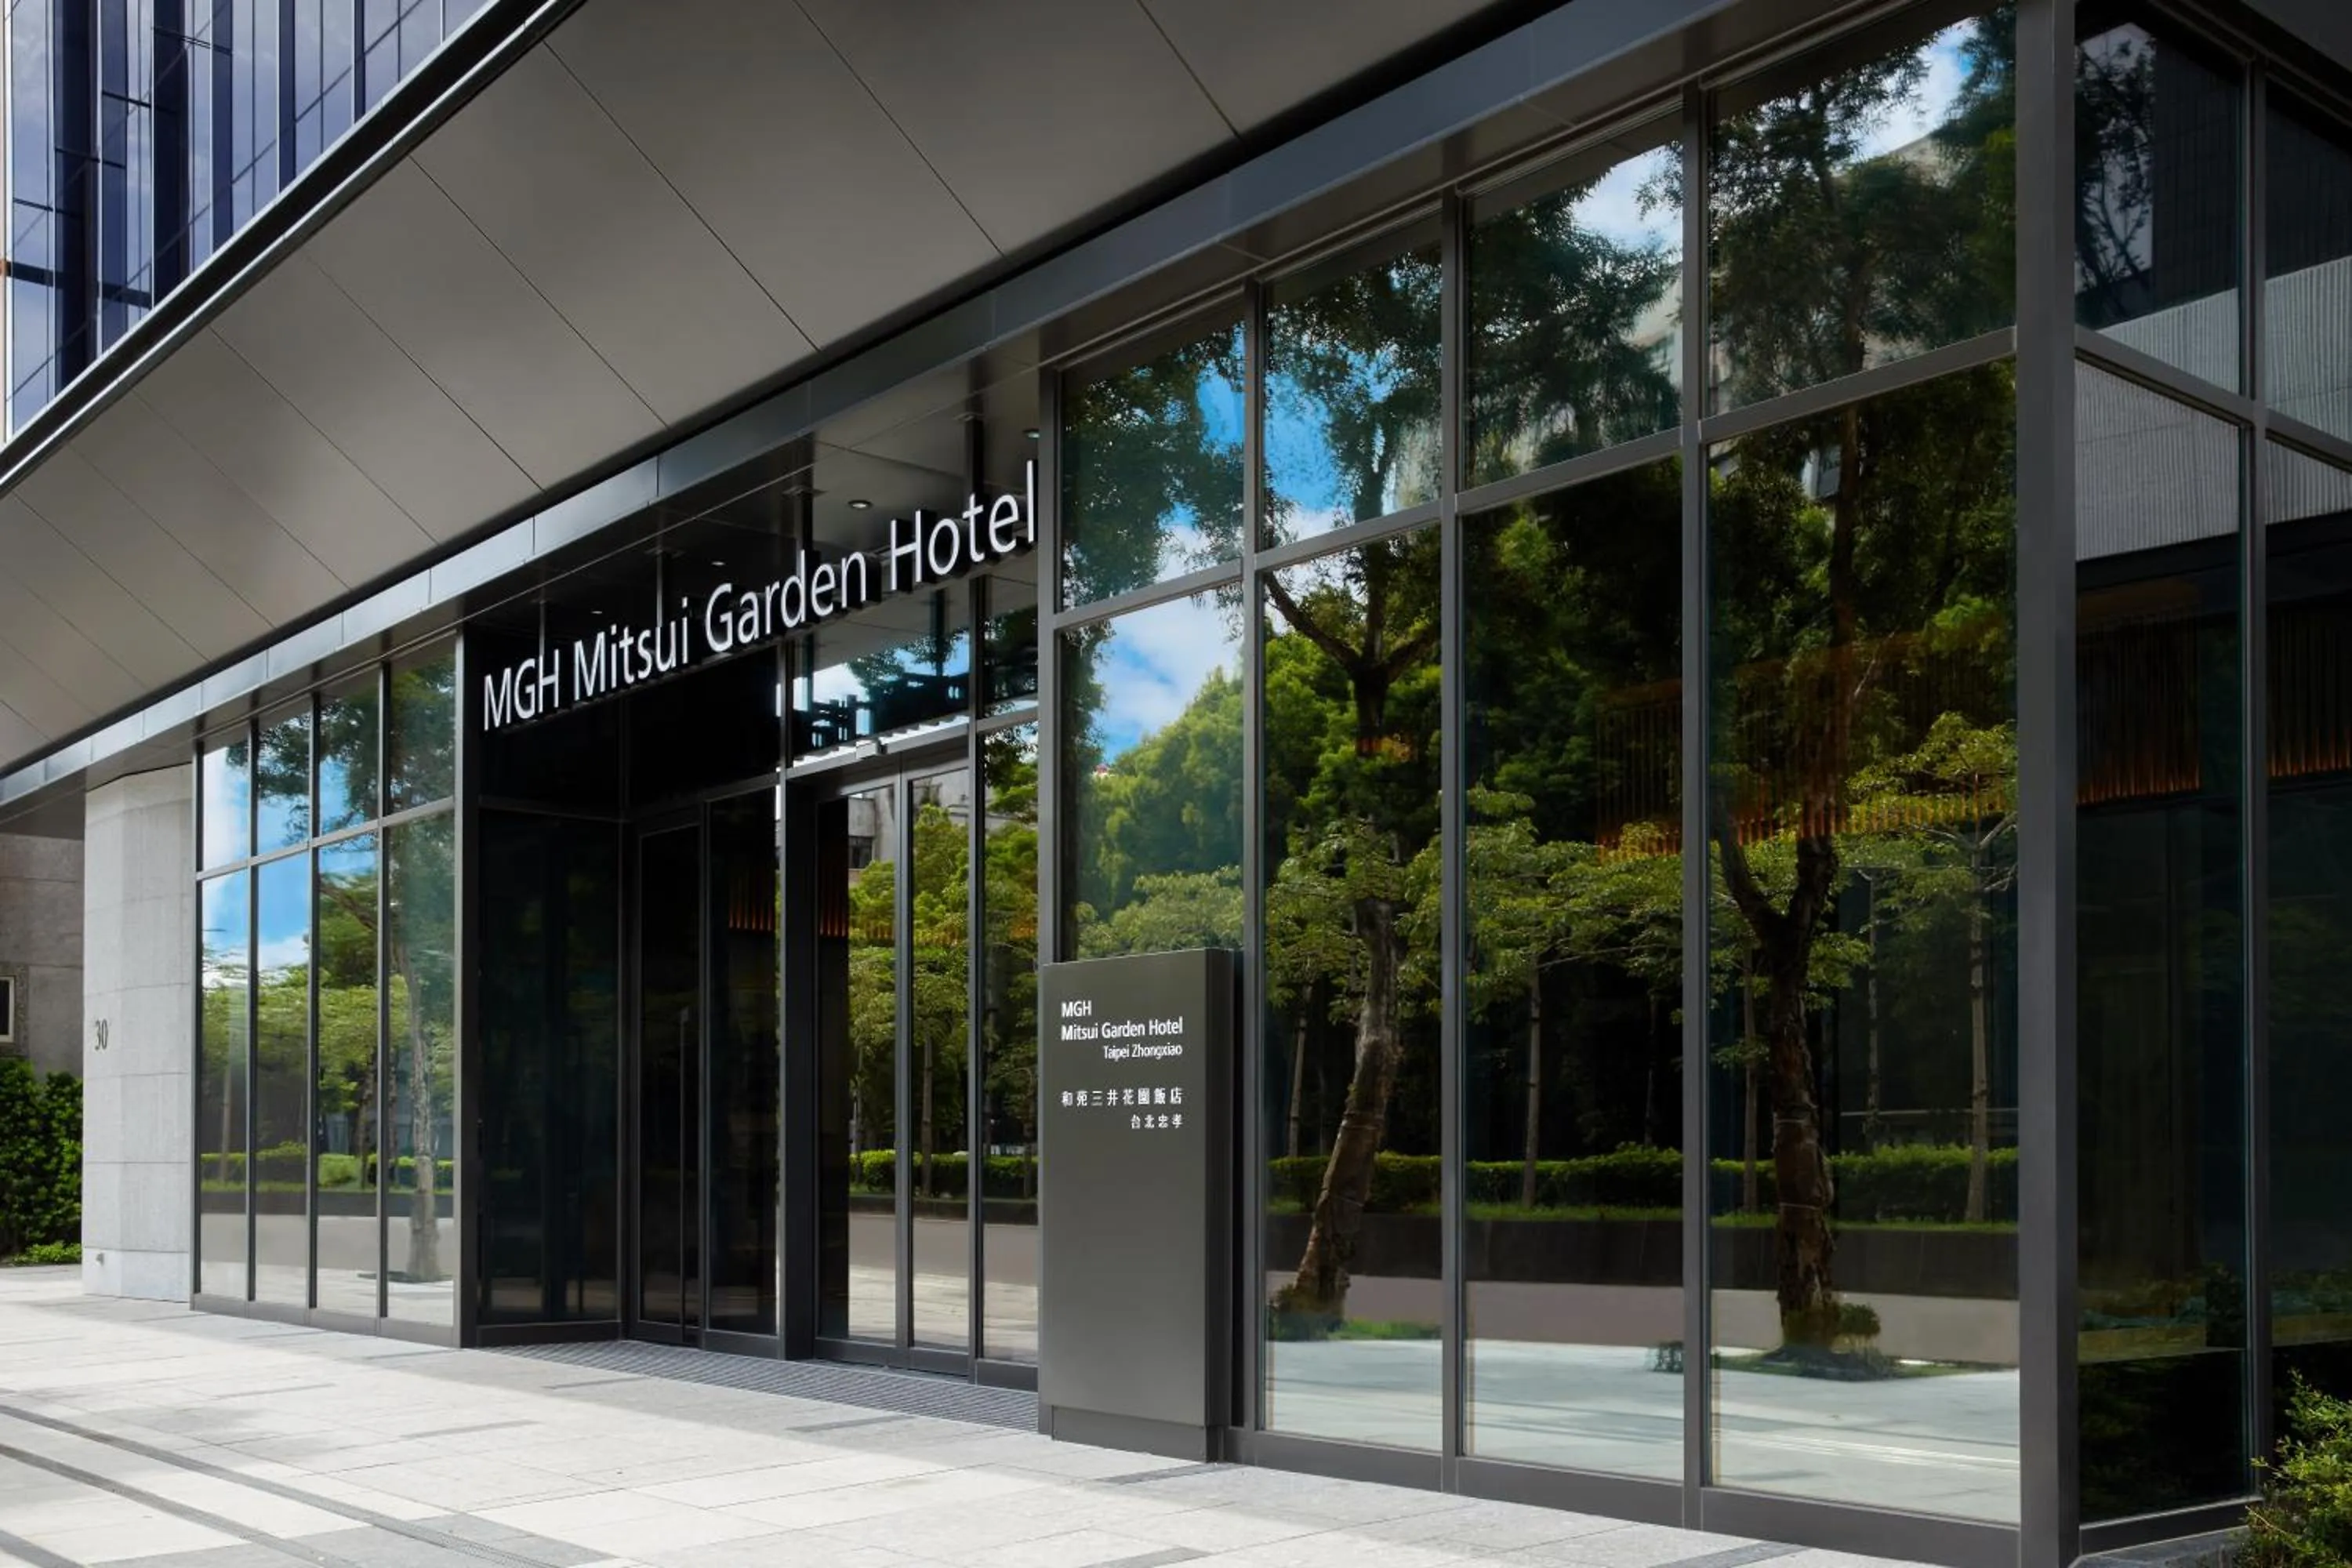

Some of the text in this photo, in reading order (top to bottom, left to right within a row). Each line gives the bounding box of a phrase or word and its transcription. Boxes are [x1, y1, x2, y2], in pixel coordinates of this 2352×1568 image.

[484, 459, 1036, 731] MGH Mitsui Garden Hotel
[1061, 1000, 1092, 1018] MGH
[94, 1018, 108, 1051] 30
[1061, 1016, 1183, 1041] Mitsui Garden Hotel
[1103, 1042, 1183, 1062] Taipei Zhongxiao
[1130, 1113, 1183, 1129] 台北忠孝
